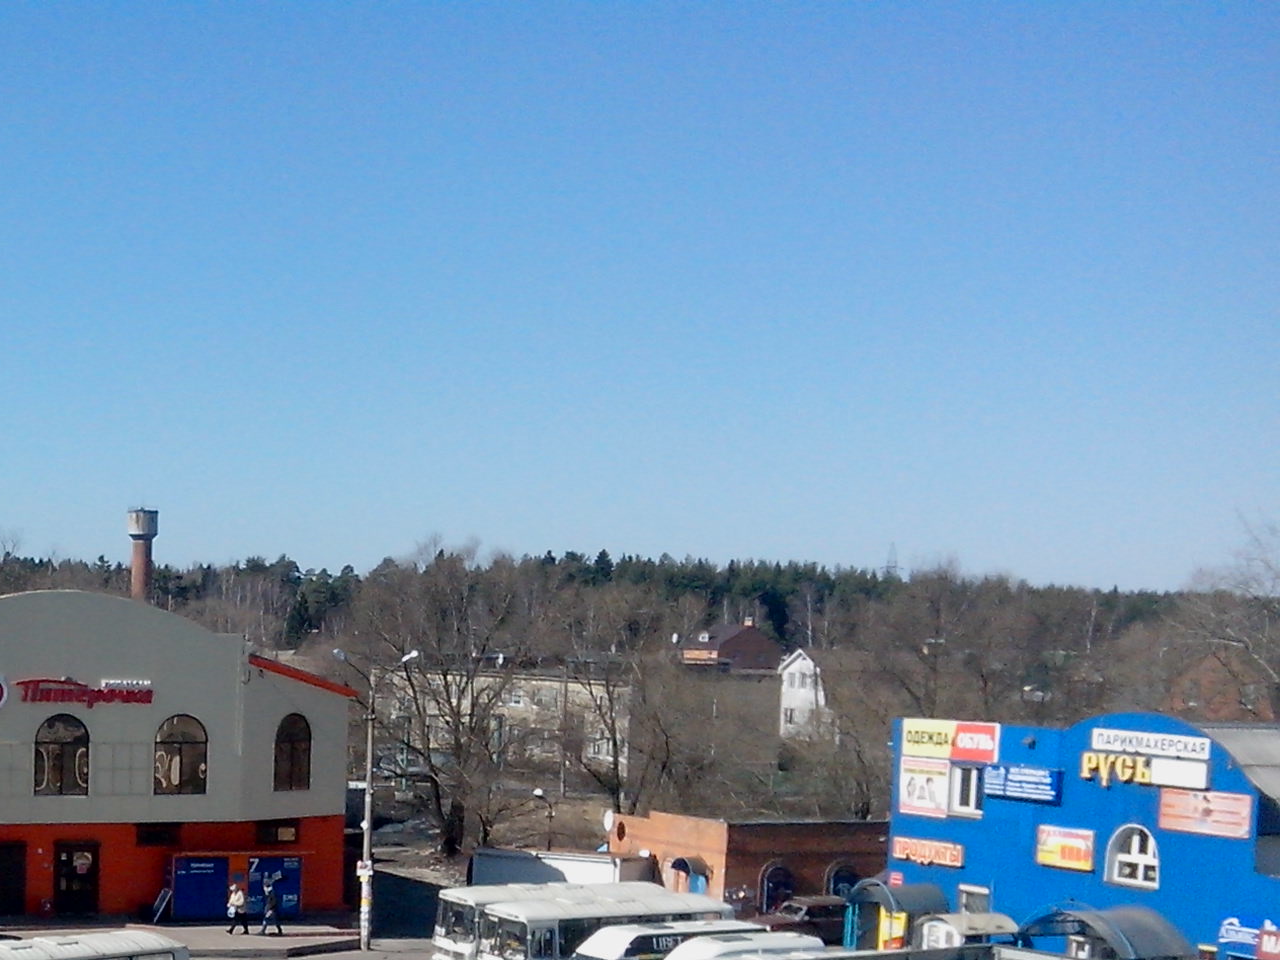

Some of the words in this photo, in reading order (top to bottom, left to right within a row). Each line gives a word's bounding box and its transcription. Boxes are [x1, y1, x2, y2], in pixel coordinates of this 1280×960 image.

[906, 730, 949, 746] ОДЕЖДА
[1096, 731, 1206, 754] ПАРИКМАХЕРСКАЯ
[1080, 752, 1152, 787] РУСЬ
[894, 838, 962, 866] ПРОДУКТЫ
